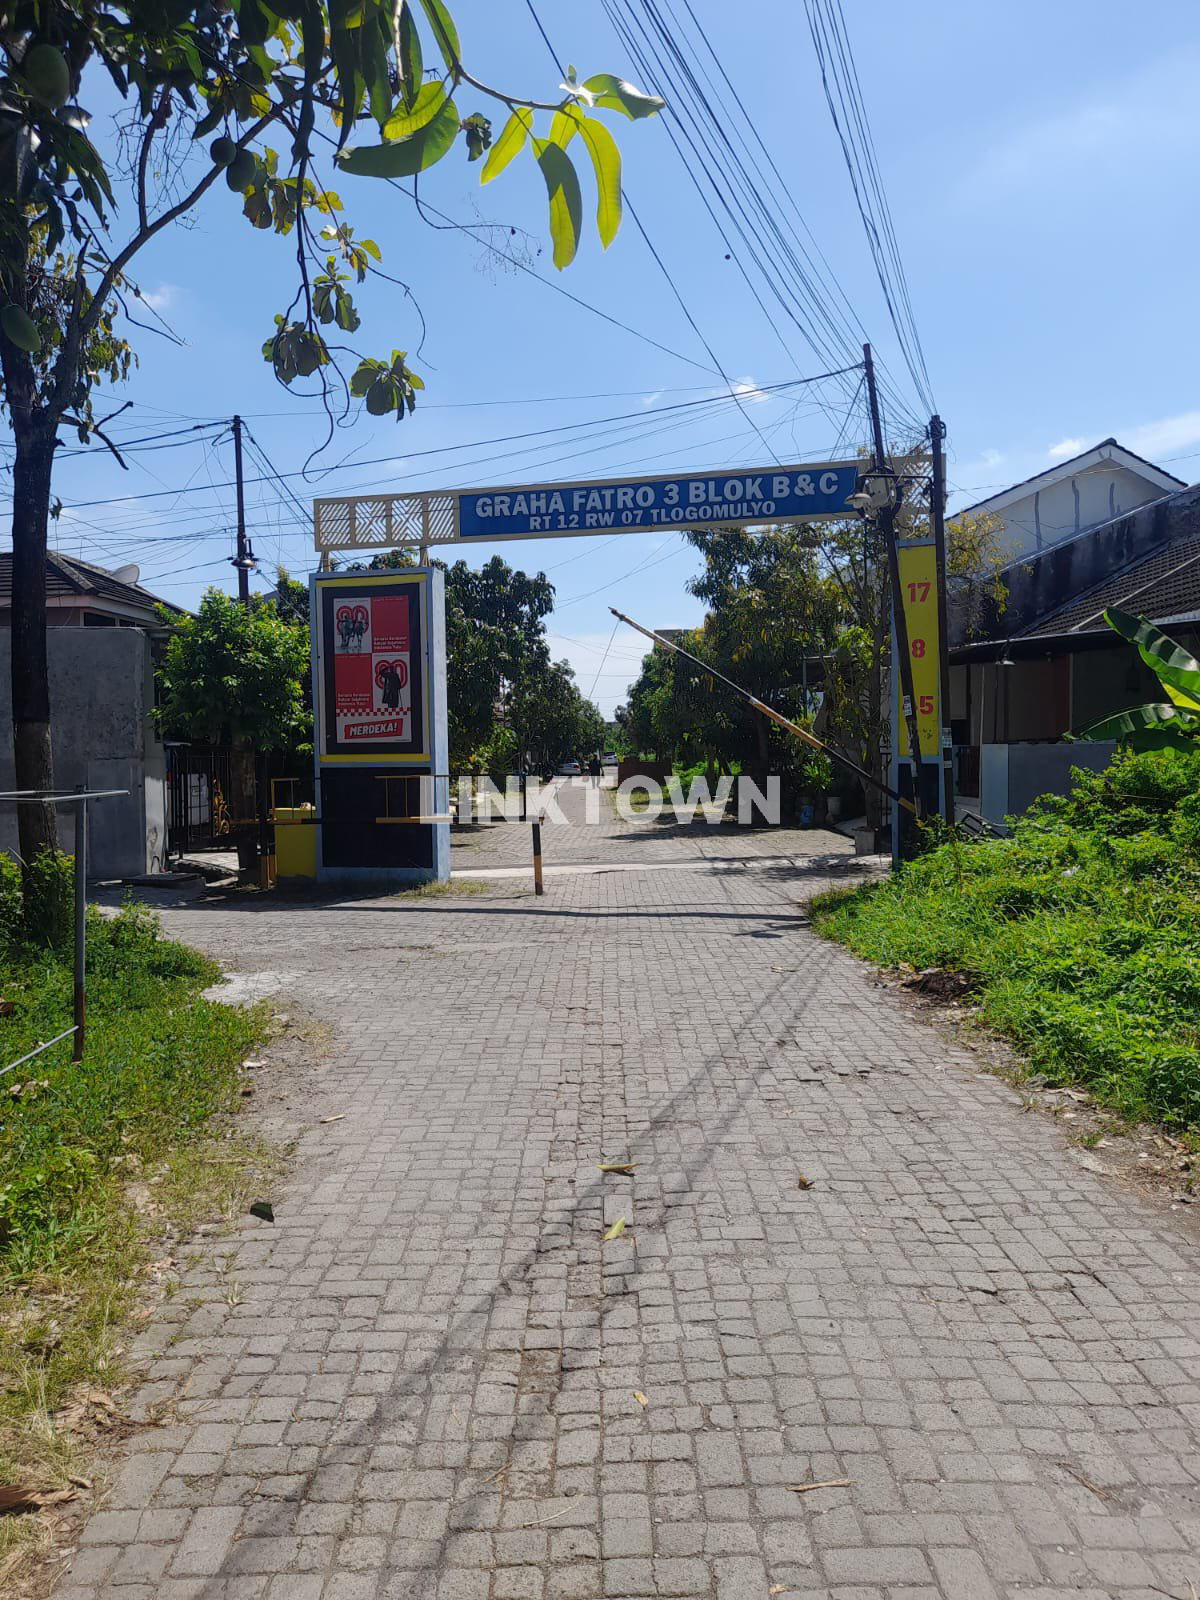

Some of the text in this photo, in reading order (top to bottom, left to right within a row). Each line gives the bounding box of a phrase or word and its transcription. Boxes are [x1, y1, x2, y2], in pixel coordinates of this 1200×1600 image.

[475, 492, 565, 518] GRAHA
[573, 486, 655, 512] FATRO
[663, 483, 679, 505] 3
[689, 477, 764, 503] BLOK
[529, 501, 776, 530] RT 12 RW 07 TLOGOMULYO
[907, 582, 931, 603] 17
[912, 639, 926, 658] 8
[349, 722, 398, 737] MERDEKA!
